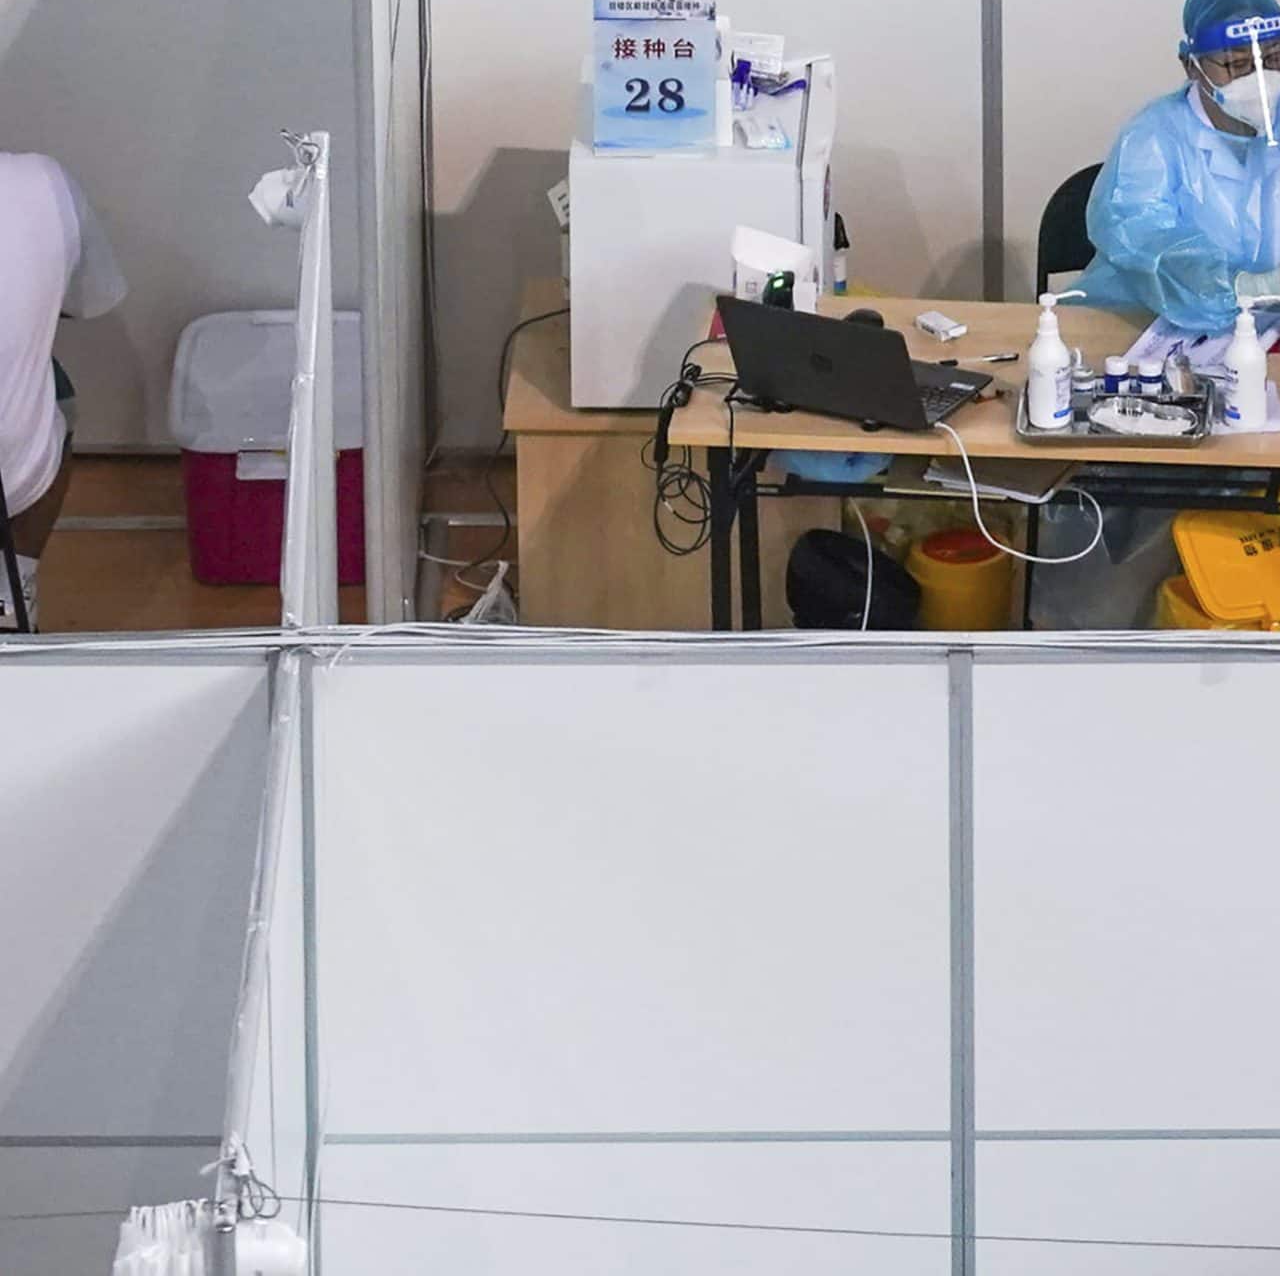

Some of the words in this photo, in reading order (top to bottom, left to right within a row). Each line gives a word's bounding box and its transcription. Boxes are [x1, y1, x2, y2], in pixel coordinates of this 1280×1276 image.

[613, 37, 696, 60] 接种台
[624, 77, 685, 114] 28
